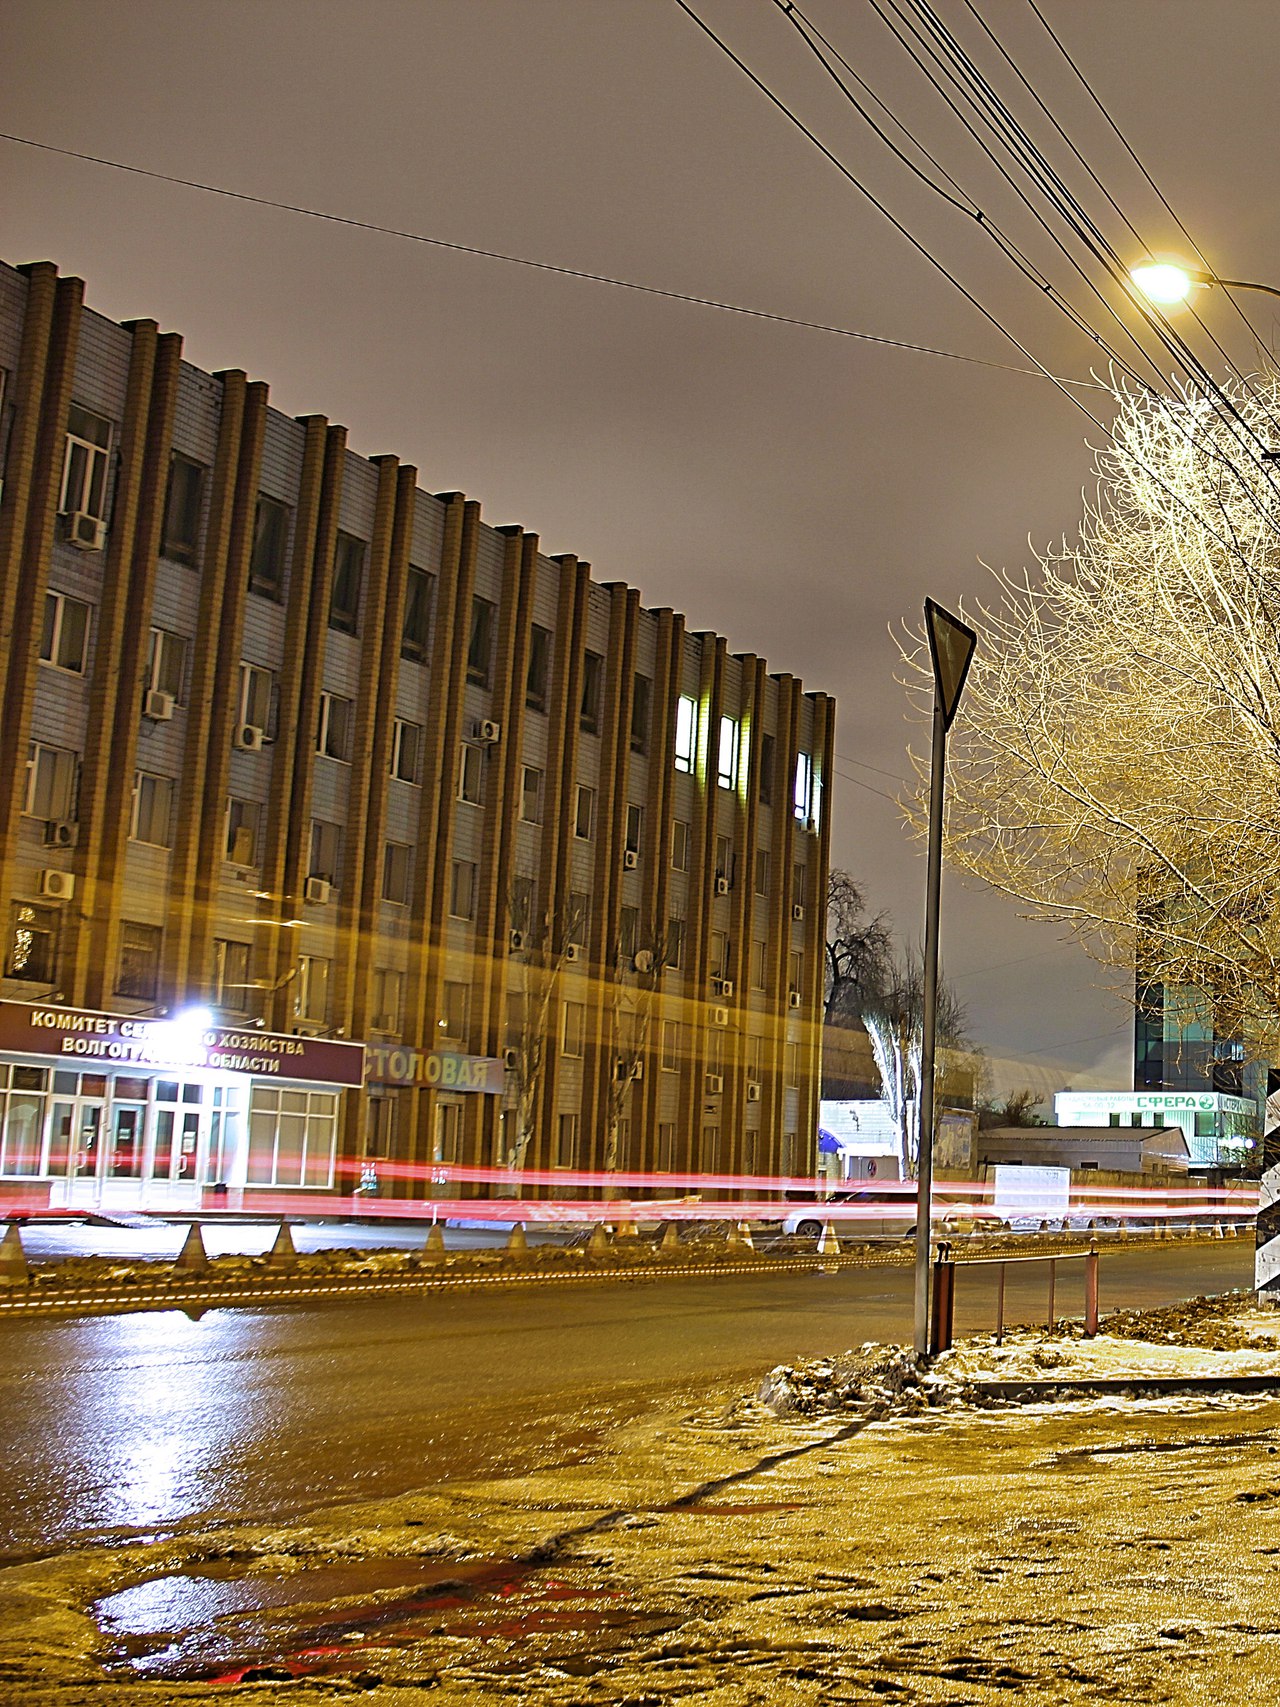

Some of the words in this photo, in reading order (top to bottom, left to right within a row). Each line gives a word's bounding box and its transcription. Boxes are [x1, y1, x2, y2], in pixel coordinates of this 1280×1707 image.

[30, 1010, 118, 1035] КОМИТЕТ
[218, 1033, 305, 1056] ХОЗЯЙСТВА
[208, 1052, 281, 1073] ОБЛАСТИ
[1137, 1096, 1196, 1108] СФЕРА
